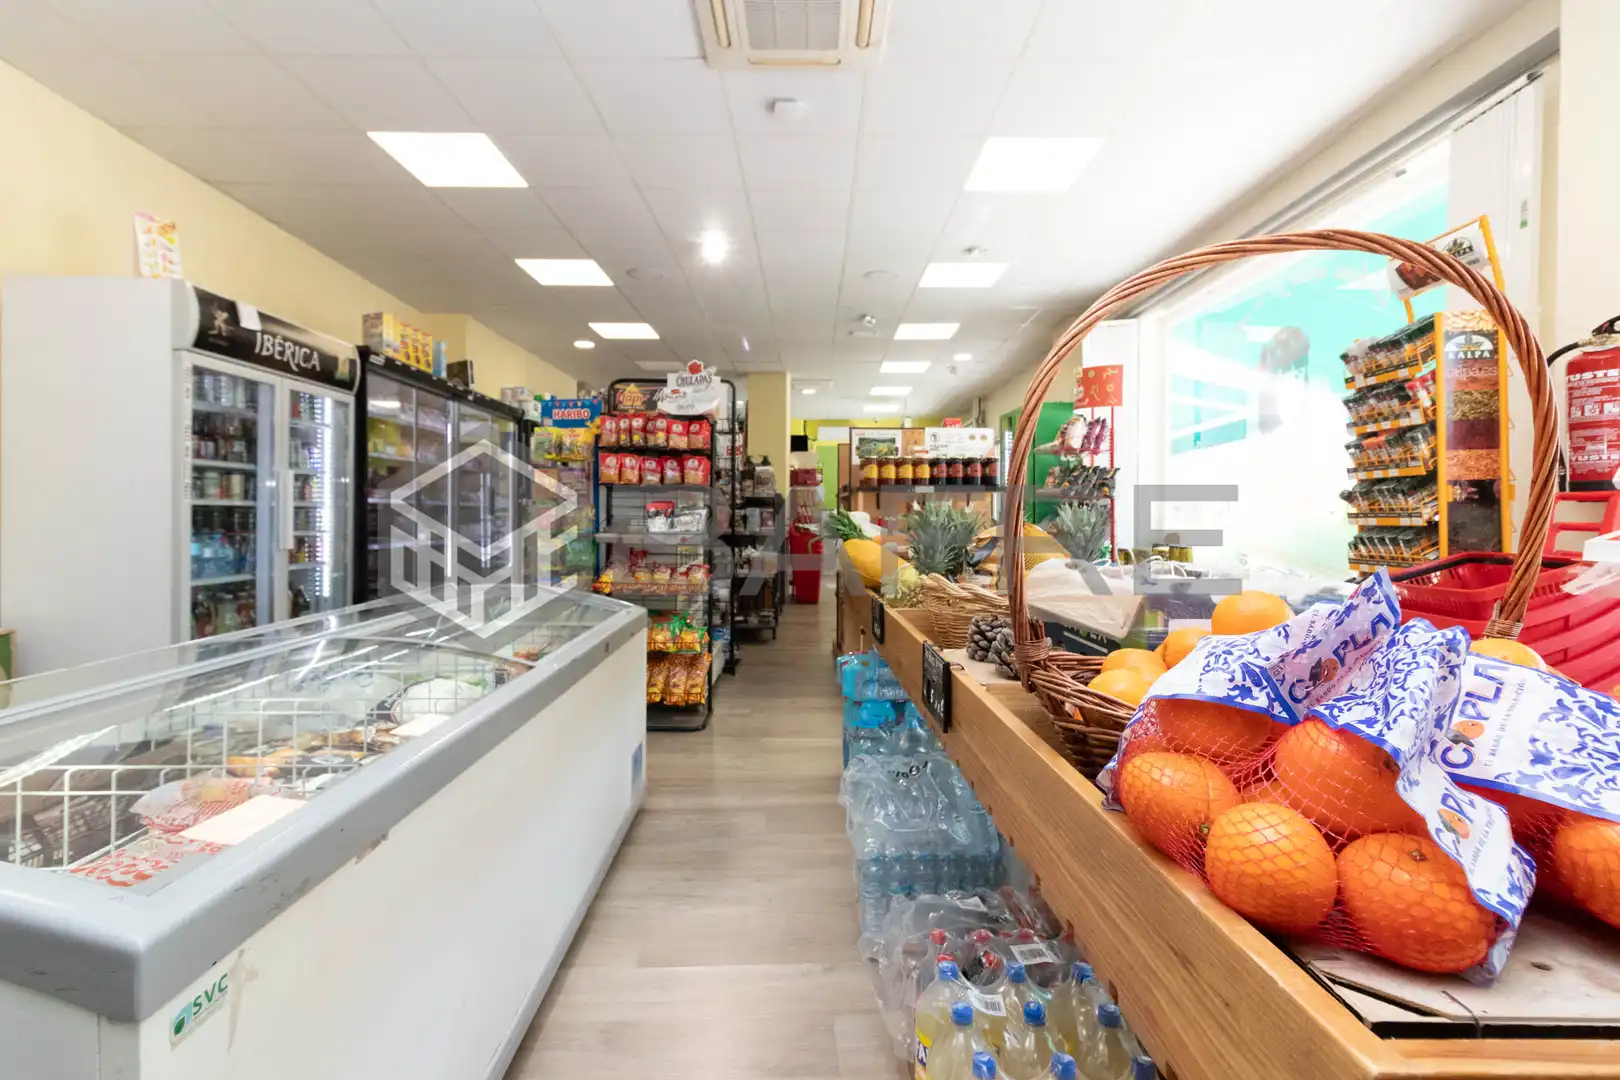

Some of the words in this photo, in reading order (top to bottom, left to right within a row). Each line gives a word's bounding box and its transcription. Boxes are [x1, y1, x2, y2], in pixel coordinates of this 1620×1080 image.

[255, 332, 320, 372] IBÉRICA
[552, 408, 591, 420] HARIBO
[1304, 619, 1316, 641] SABO
[193, 973, 228, 1016] SVC
